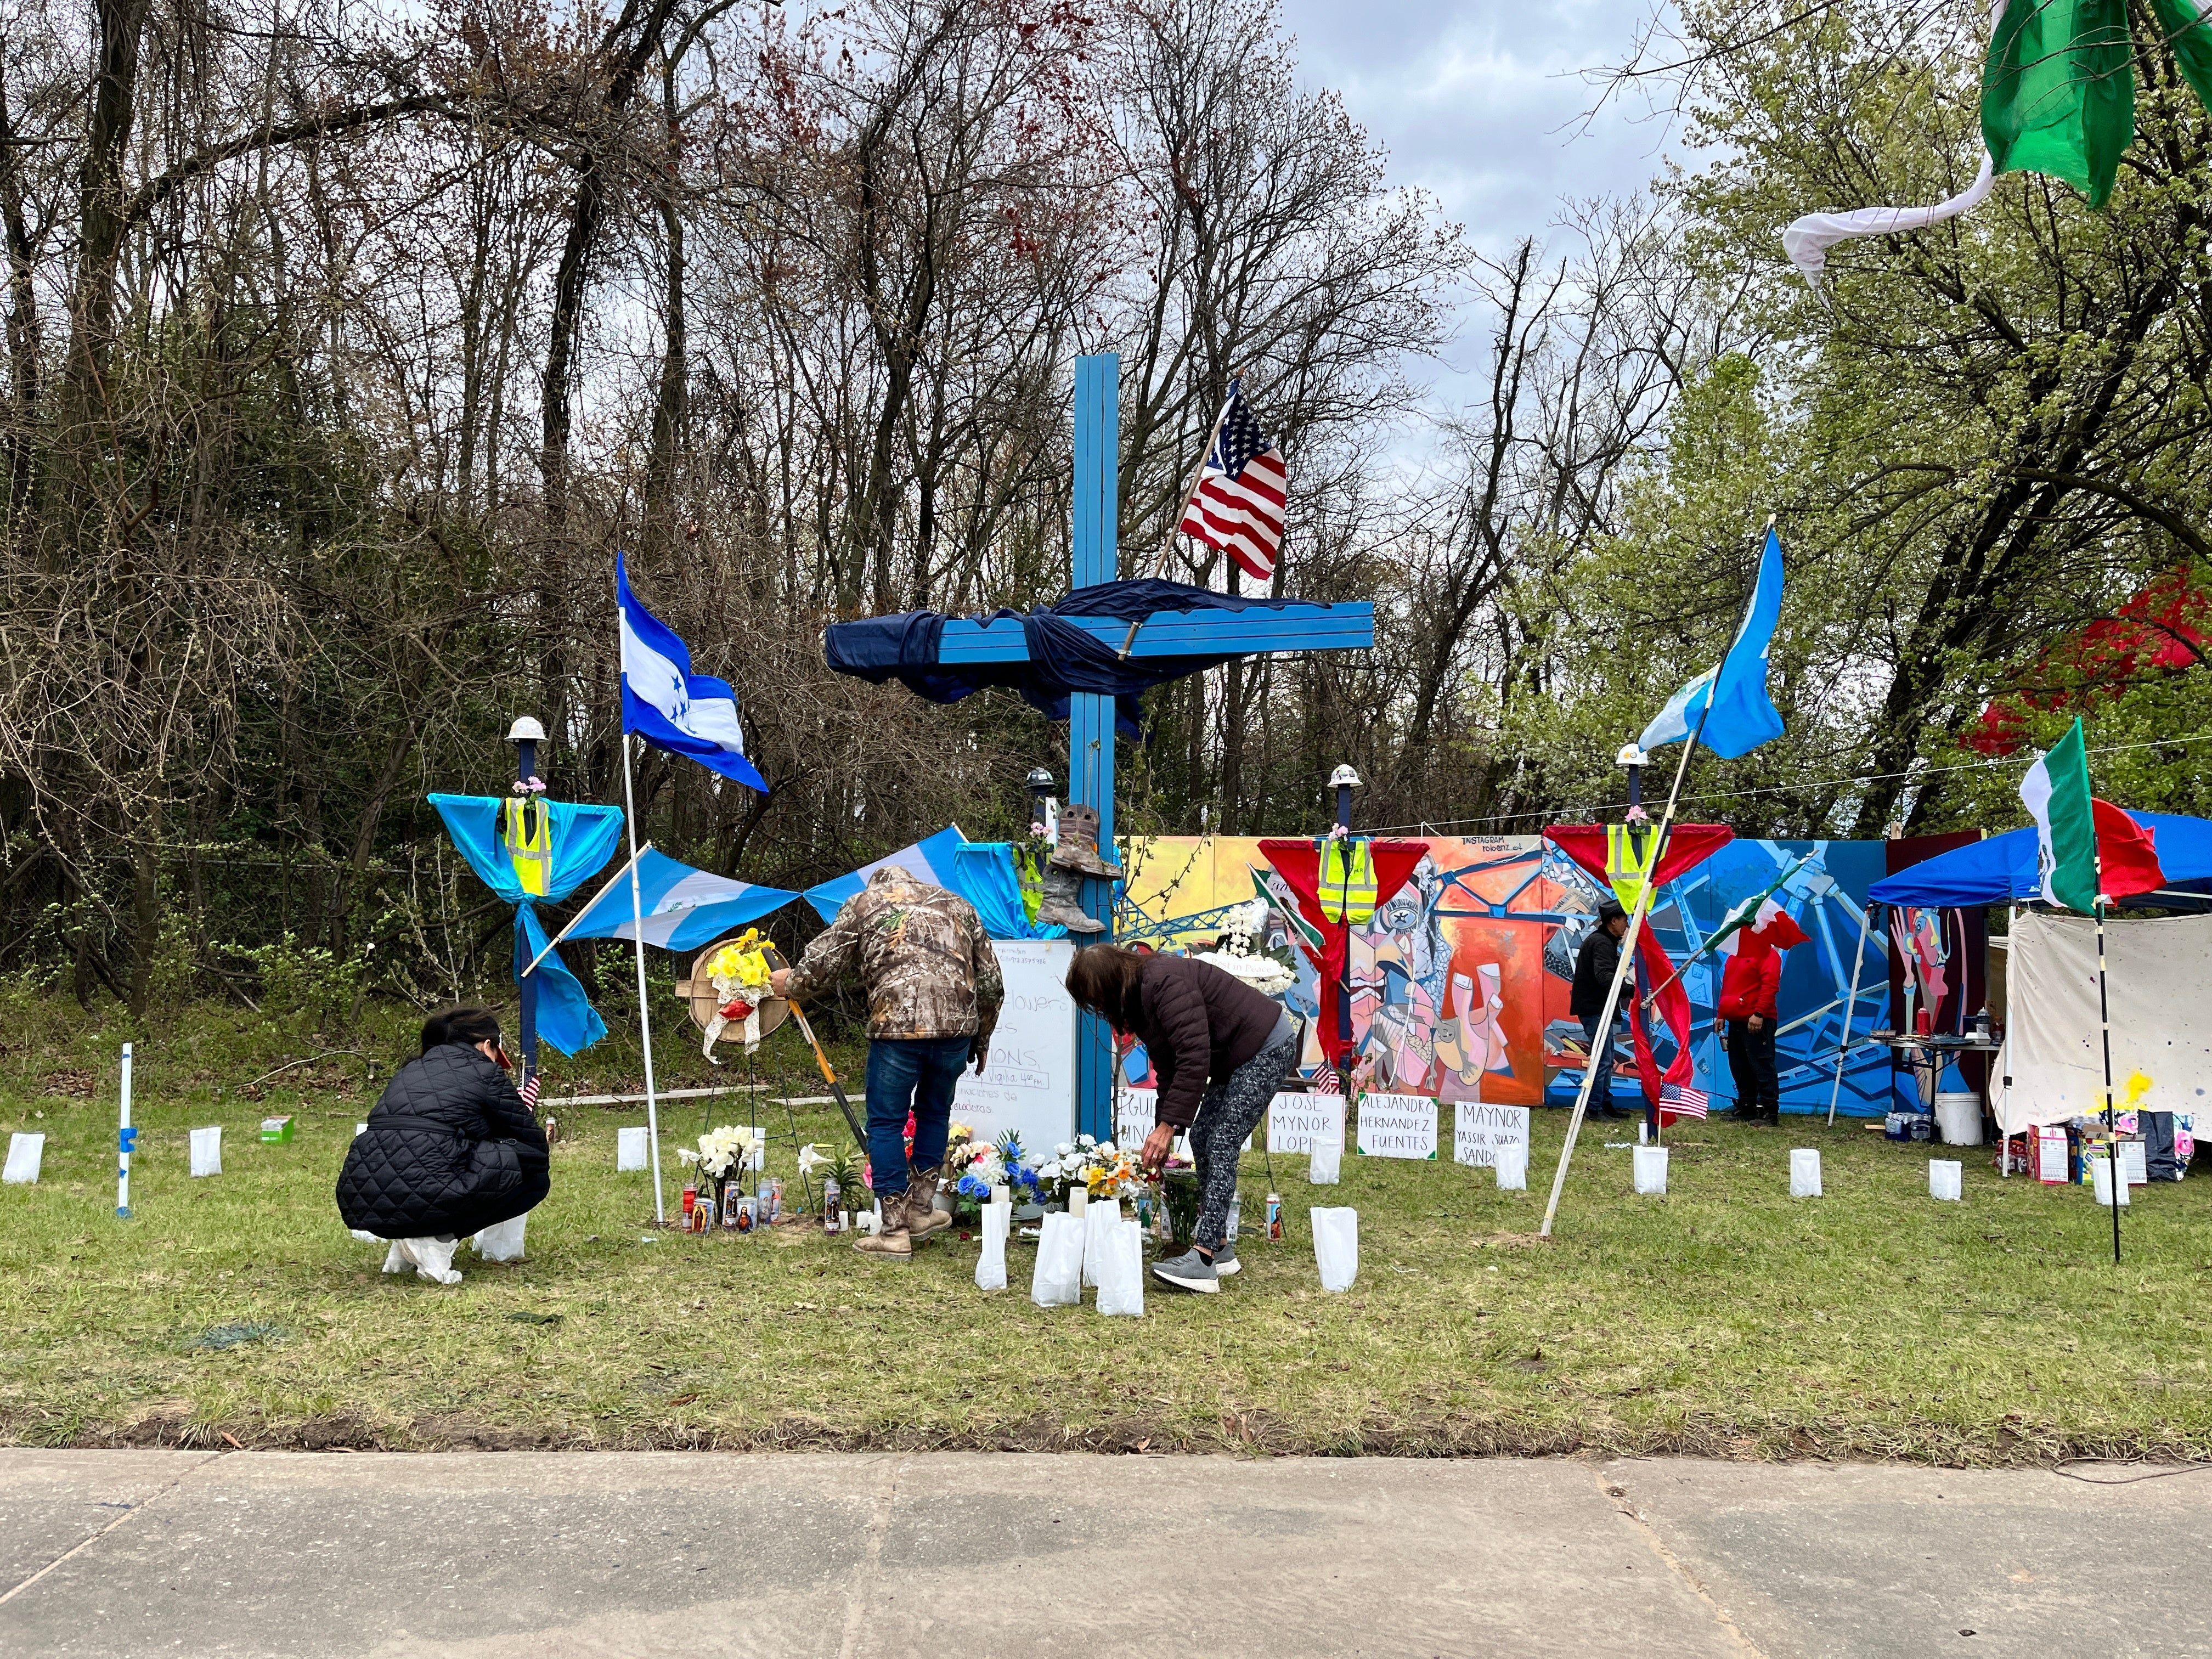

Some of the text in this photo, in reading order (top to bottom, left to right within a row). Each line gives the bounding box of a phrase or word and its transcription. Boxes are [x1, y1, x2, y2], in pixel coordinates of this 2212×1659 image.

[1462, 836, 1504, 845] INSTAGRAM
[1211, 958, 1231, 969] Rest
[1245, 963, 1272, 973] Peace
[1003, 989, 1069, 1014] Flowers
[988, 1066, 1018, 1085] Vigilia
[1004, 1089, 1018, 1101] de
[1279, 1095, 1322, 1111] JOSE
[1362, 1095, 1435, 1115] ALEJANDRO
[1273, 1116, 1332, 1131] MYNOR
[1361, 1116, 1430, 1131] HERNANDEZ
[1464, 1105, 1522, 1129] MAYNOR
[1373, 1135, 1427, 1150] FUENTES
[1457, 1130, 1520, 1146] YASSIR SUAZO
